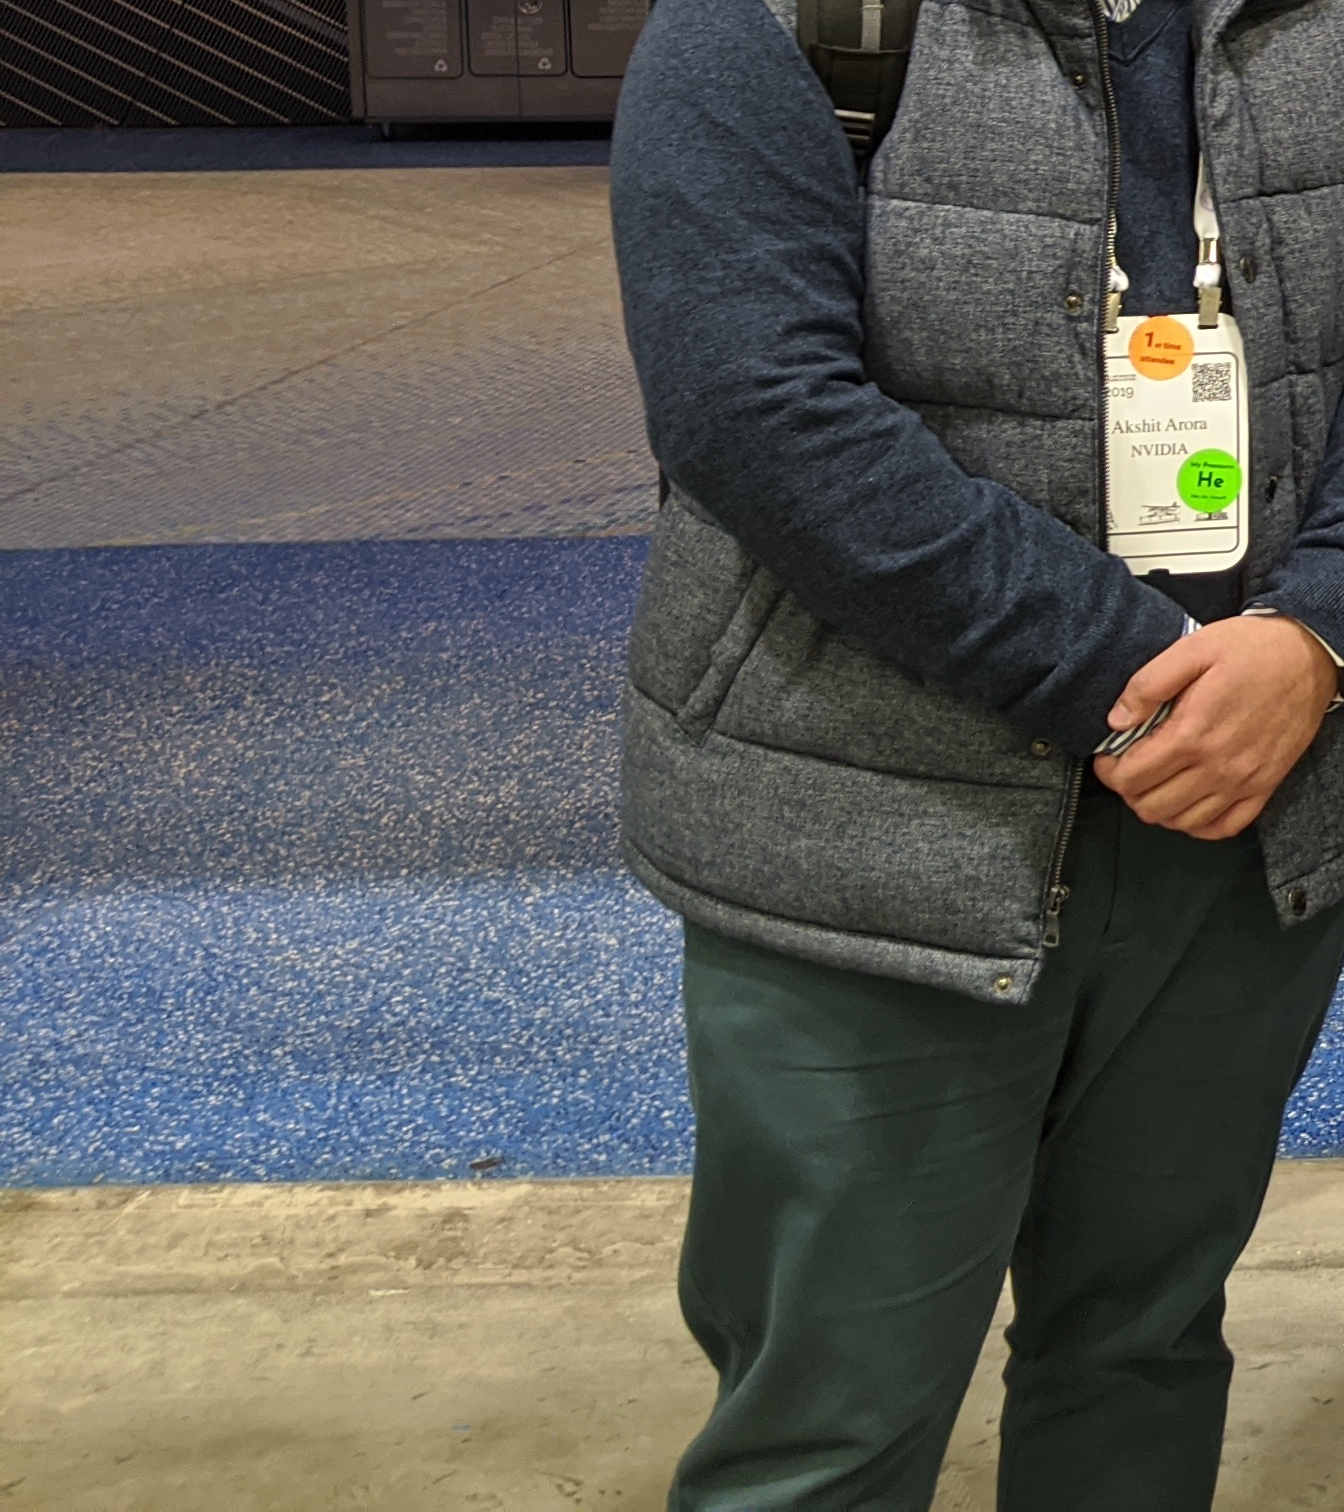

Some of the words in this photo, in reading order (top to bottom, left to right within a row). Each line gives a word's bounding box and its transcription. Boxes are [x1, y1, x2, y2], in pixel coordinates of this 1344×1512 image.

[1112, 419, 1161, 434] Akshit
[1165, 418, 1208, 431] Arora
[1131, 443, 1188, 457] NVIDIA
[1197, 470, 1224, 488] He
